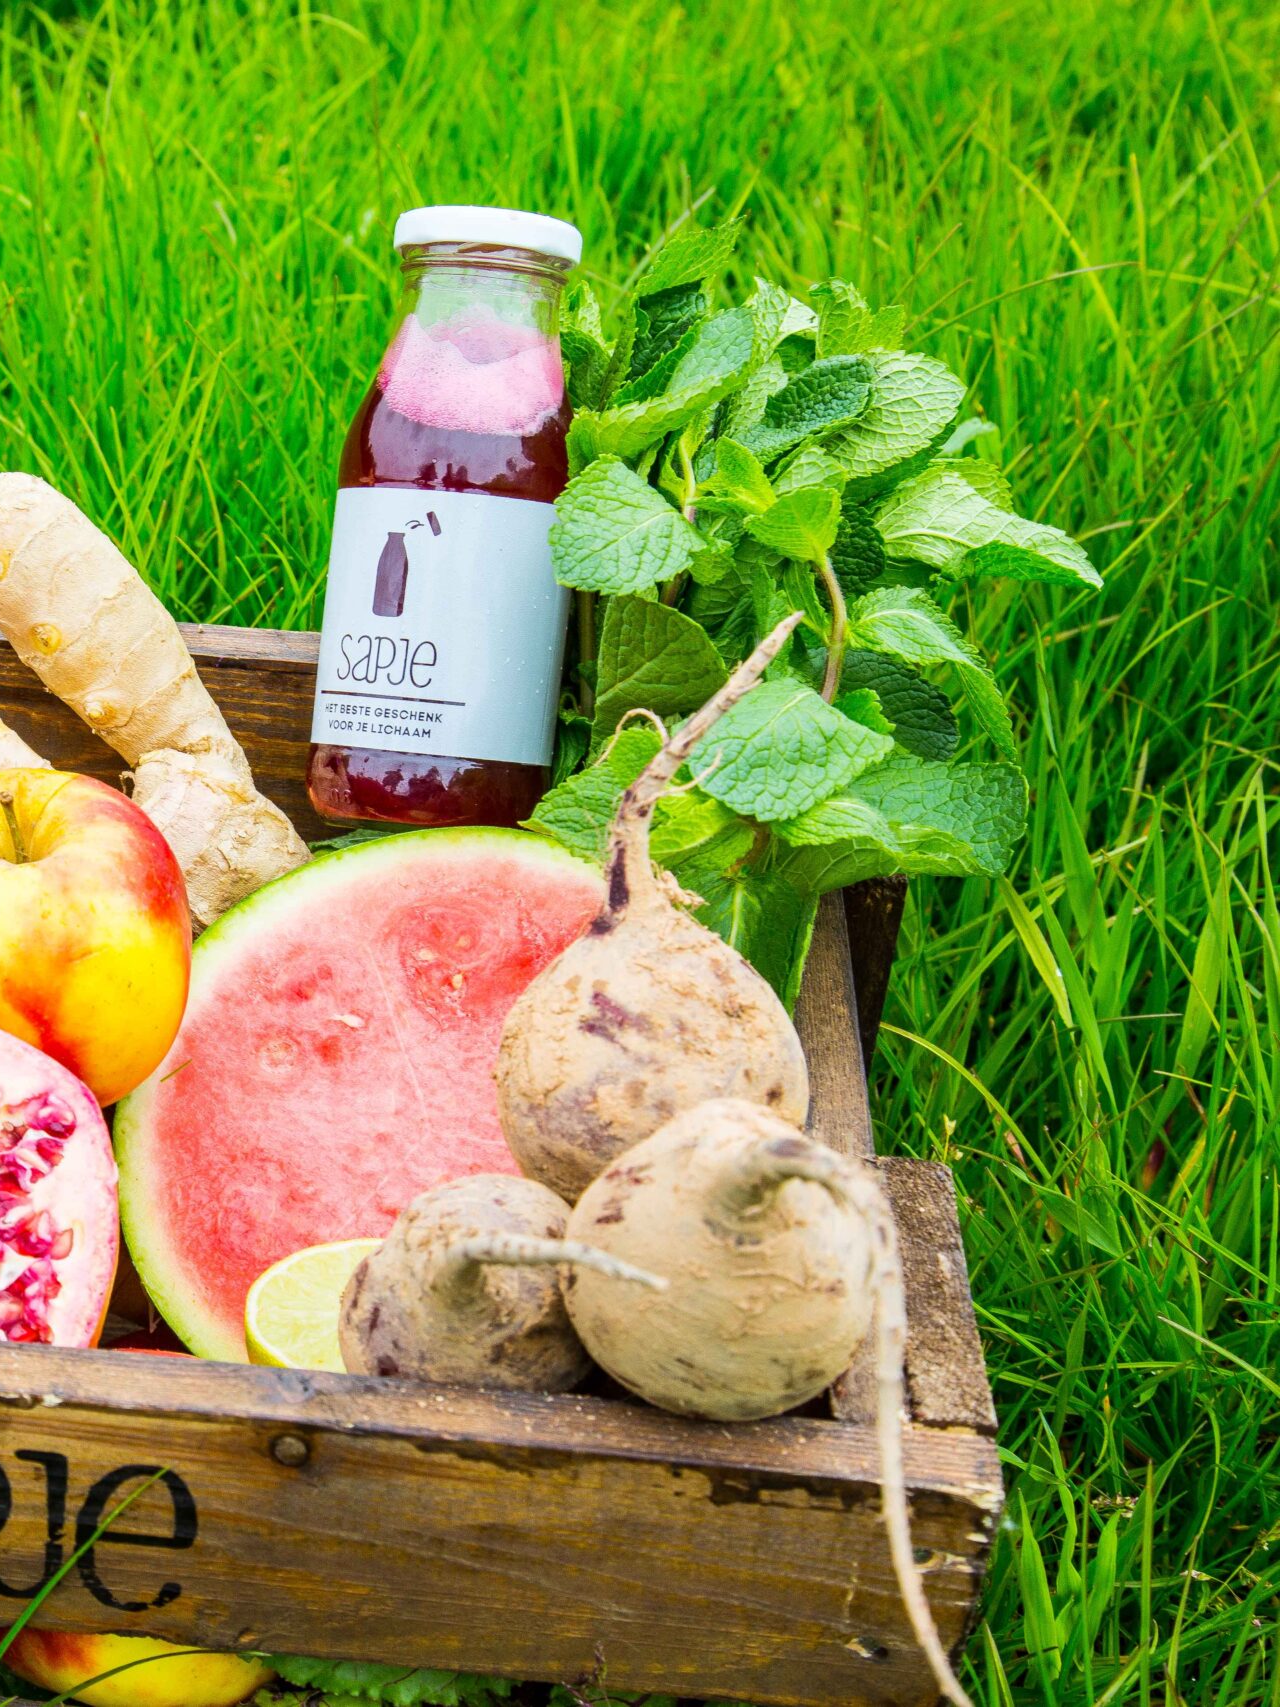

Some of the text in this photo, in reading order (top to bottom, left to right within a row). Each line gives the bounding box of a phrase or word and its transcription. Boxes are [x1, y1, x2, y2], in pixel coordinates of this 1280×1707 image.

[325, 703, 443, 723] HET BESTE GESCHENK
[328, 720, 431, 738] VOOR JE LICHAAM
